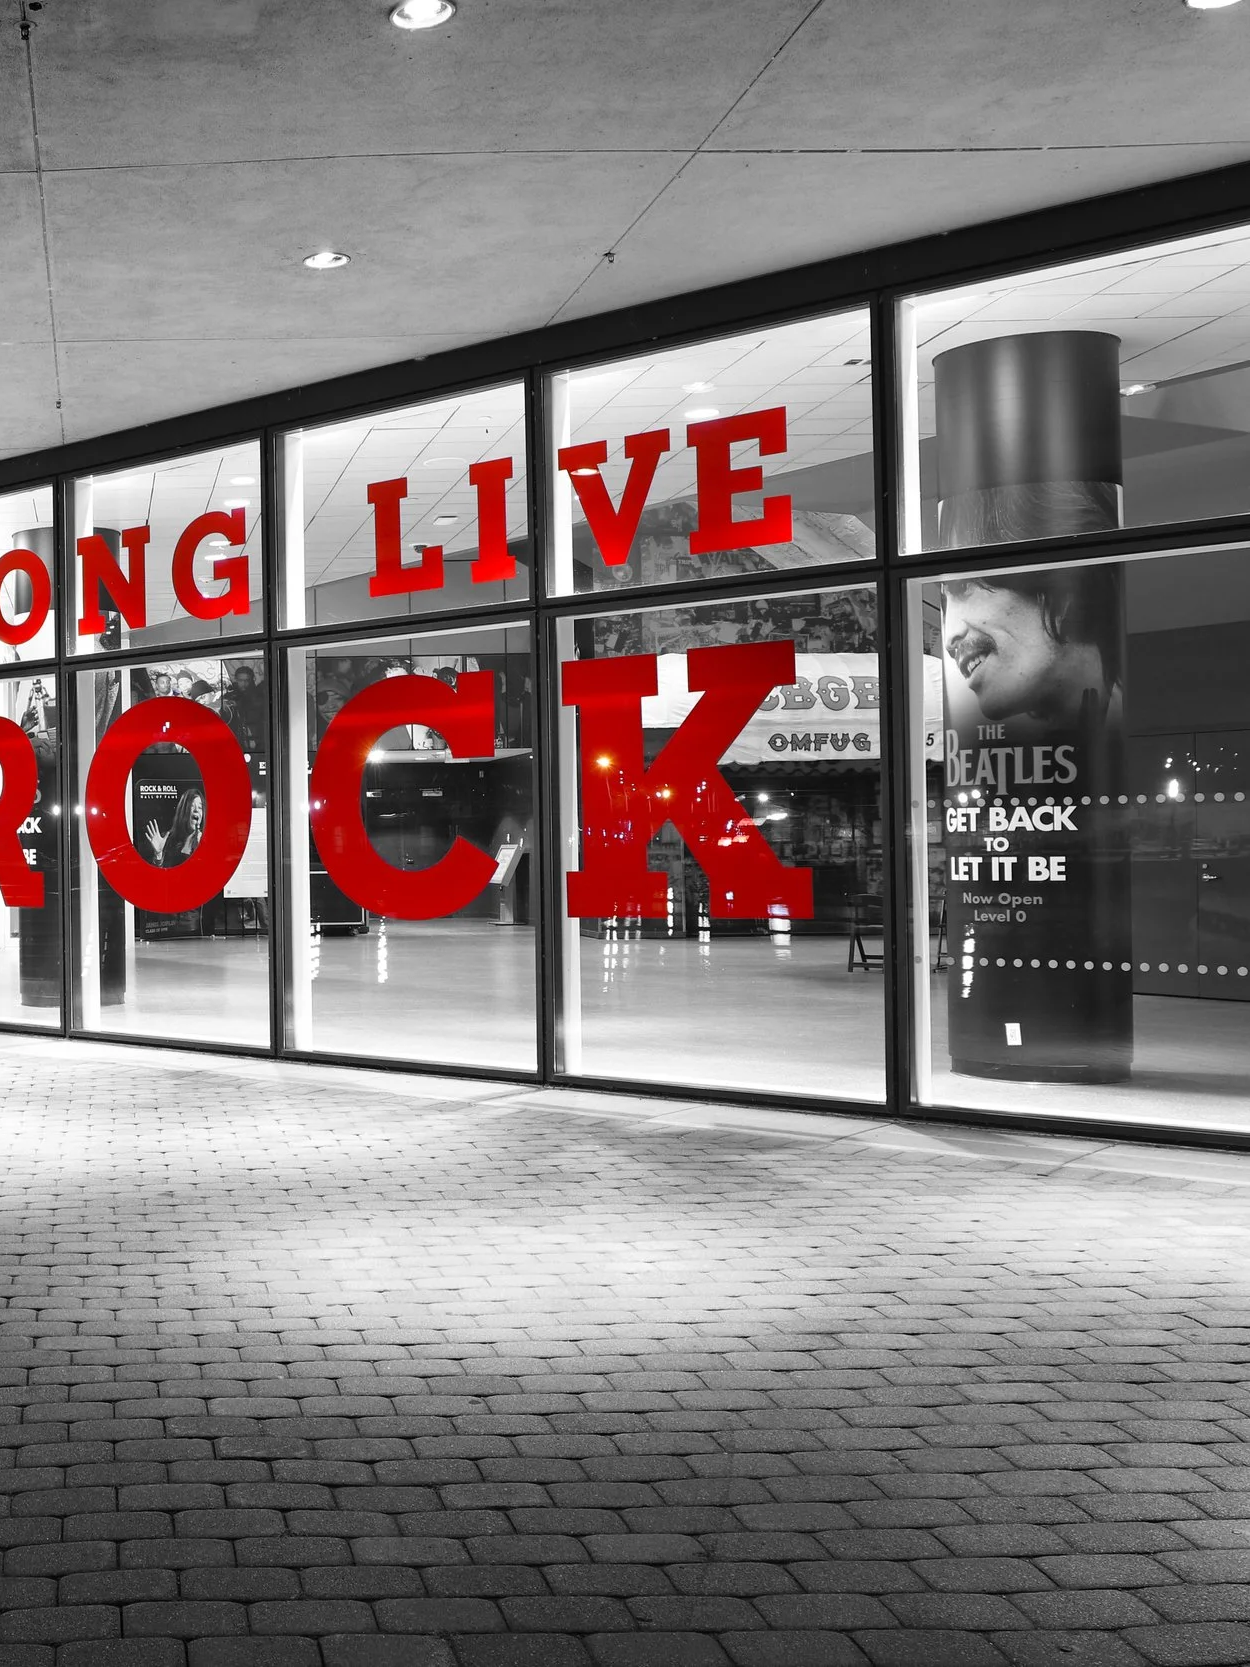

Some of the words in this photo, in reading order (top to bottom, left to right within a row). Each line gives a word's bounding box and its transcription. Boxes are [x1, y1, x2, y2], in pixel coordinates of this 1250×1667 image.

[368, 406, 794, 599] LIVE
[977, 724, 1006, 740] THE
[768, 733, 871, 752] OMFUG
[946, 729, 1078, 795] BEATLES
[946, 807, 981, 833] GET
[989, 805, 1079, 832] BACK
[983, 836, 1010, 852] TO
[950, 856, 983, 881] LET
[991, 856, 1018, 881] IT
[1028, 856, 1067, 881] BE
[963, 892, 993, 904] Now
[998, 892, 1043, 908] Open
[974, 909, 1010, 922] Level
